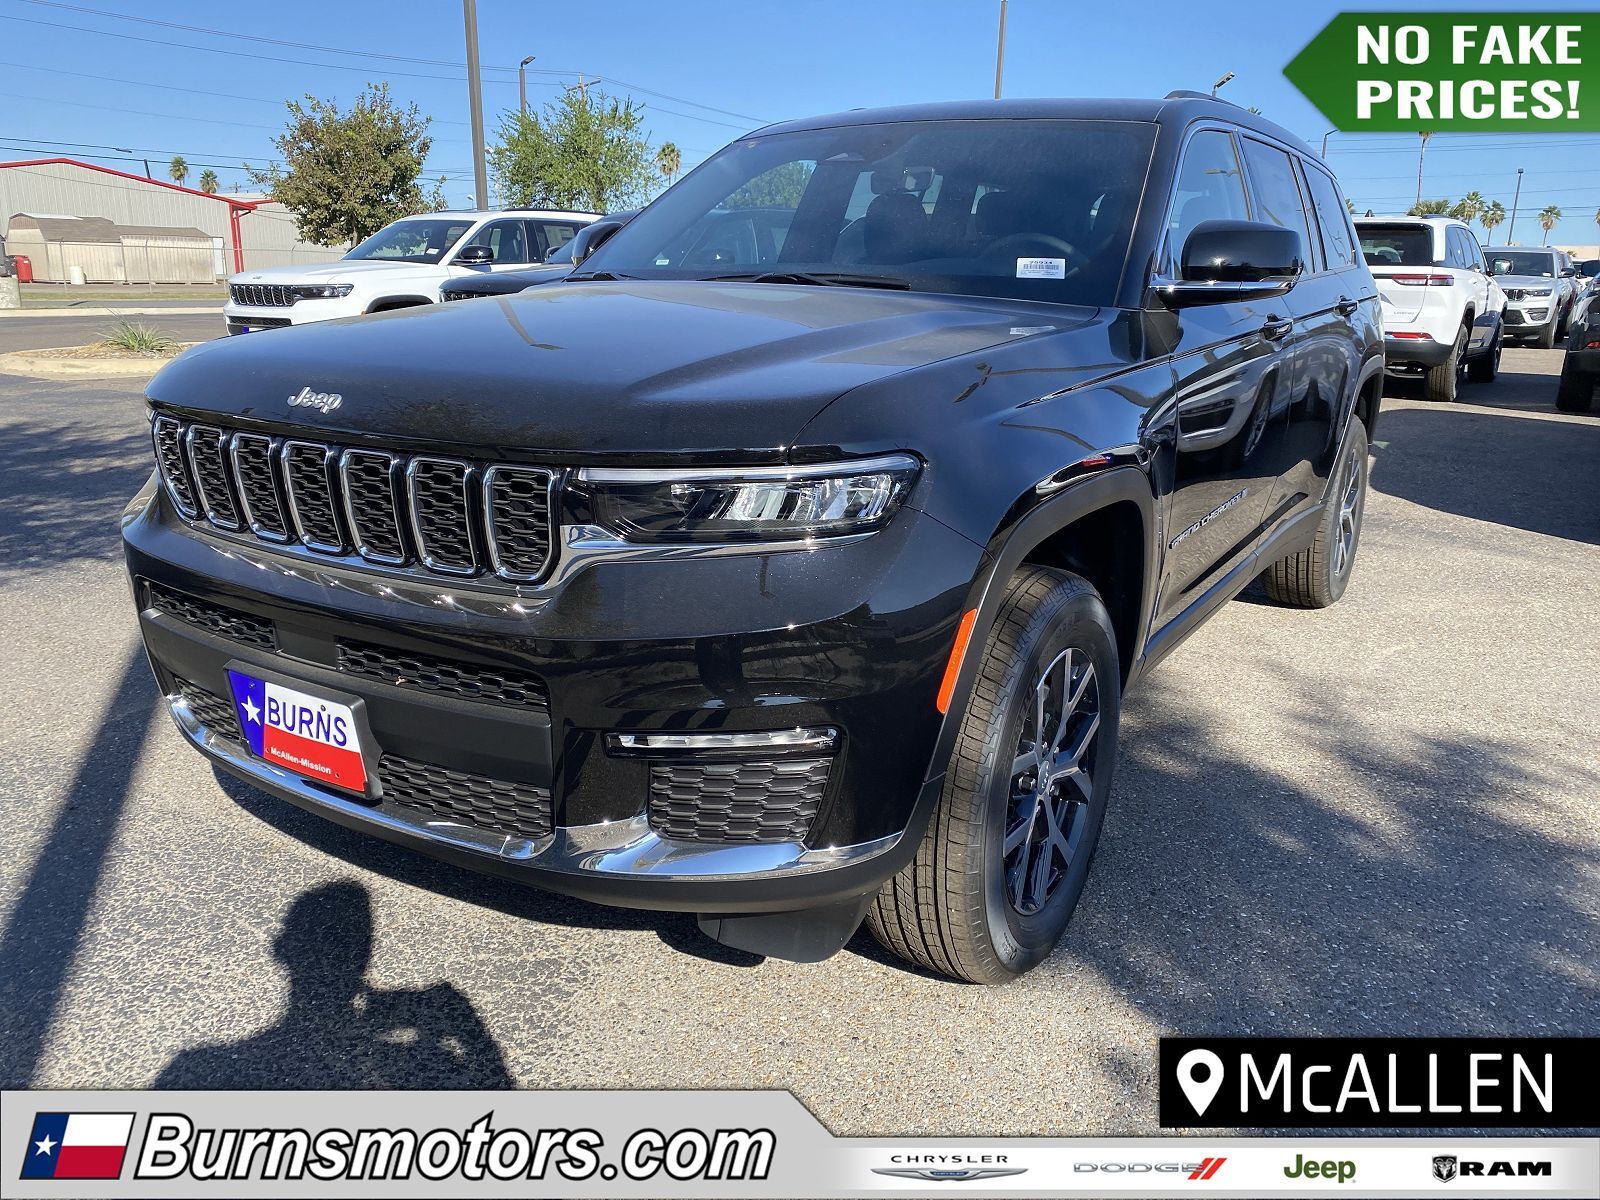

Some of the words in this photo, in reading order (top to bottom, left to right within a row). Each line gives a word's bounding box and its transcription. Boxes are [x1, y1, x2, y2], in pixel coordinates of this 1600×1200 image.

[286, 386, 343, 414] Jeep
[267, 696, 347, 747] BURNS
[270, 746, 332, 775] McAllen-Mission
